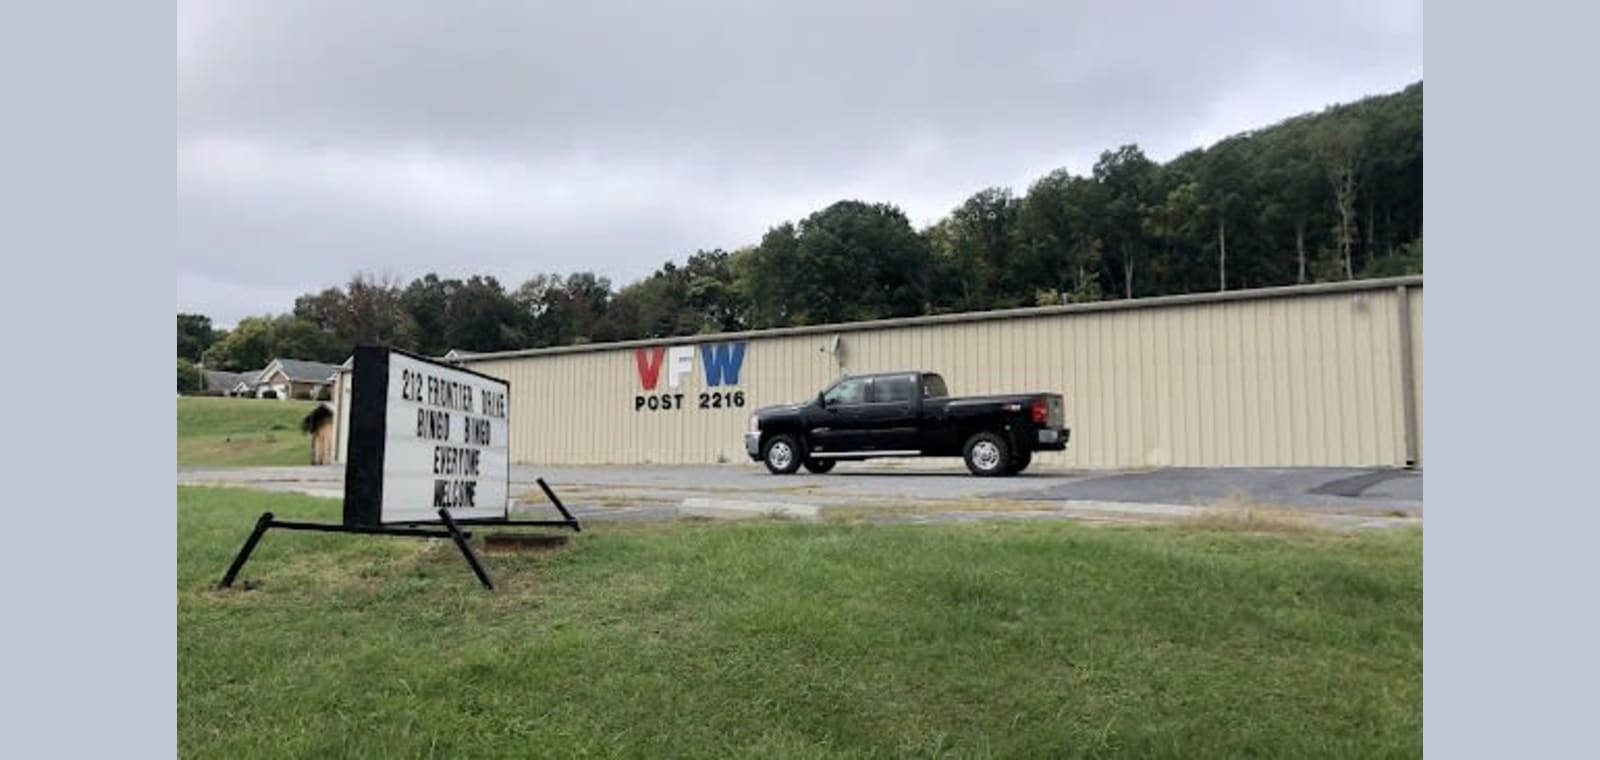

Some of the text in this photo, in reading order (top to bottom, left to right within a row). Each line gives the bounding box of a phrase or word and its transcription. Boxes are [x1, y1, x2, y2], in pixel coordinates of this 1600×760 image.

[635, 342, 746, 391] VFW
[402, 369, 505, 418] 212 FRONTIER DRIVE
[635, 391, 745, 411] POST 2216
[417, 408, 490, 446] BINGO BINGO
[434, 446, 480, 476] EVERYONE
[434, 480, 477, 507] WELCOME
